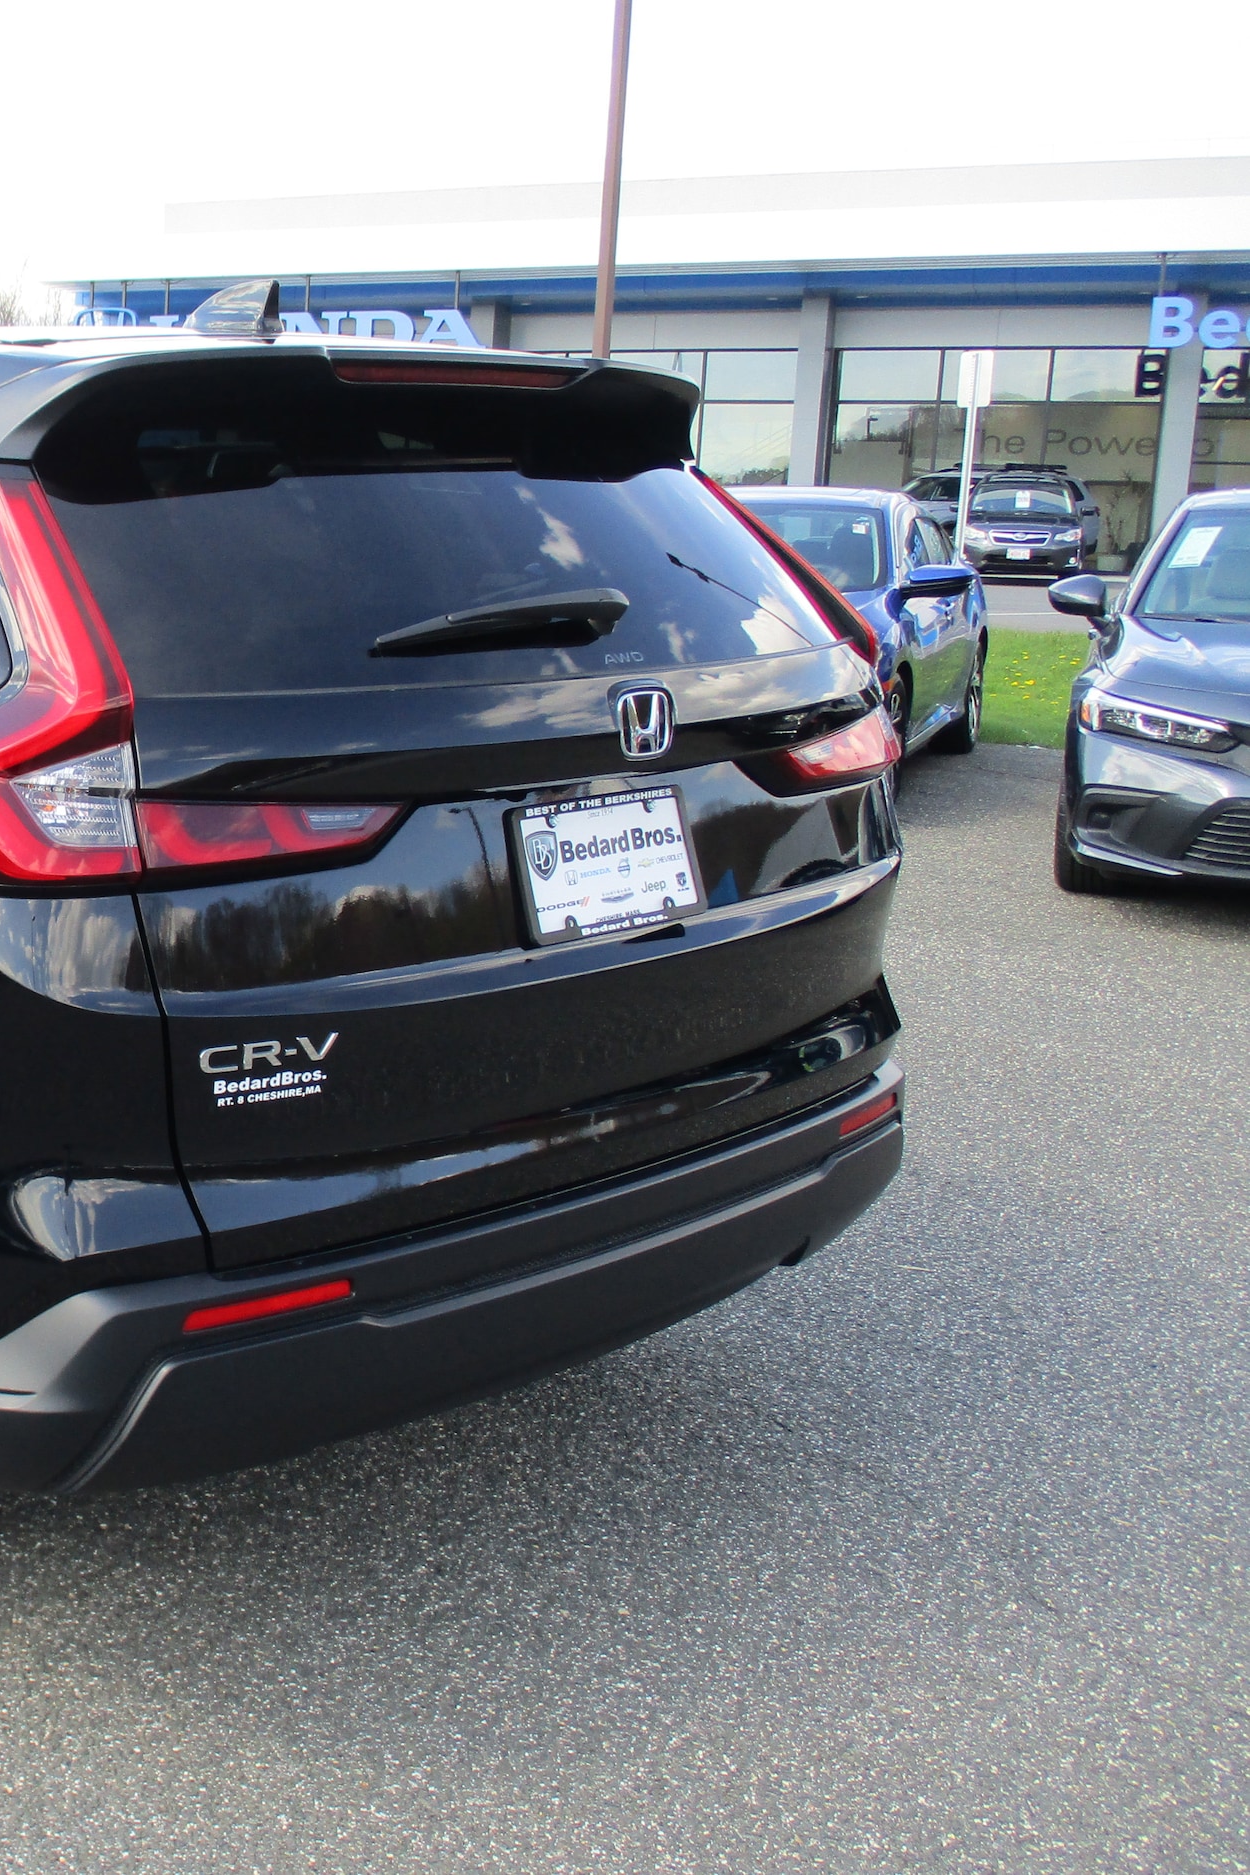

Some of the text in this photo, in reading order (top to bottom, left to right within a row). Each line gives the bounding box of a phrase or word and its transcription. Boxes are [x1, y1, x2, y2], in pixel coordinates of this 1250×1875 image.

[150, 308, 487, 349] NDA
[1148, 296, 1250, 349] Be
[1044, 429, 1161, 457] Powe
[604, 651, 644, 665] AWD
[525, 788, 672, 818] BEST OF THE BERKSHIRES
[580, 867, 611, 879] HONDA
[641, 880, 667, 893] Jeep
[581, 914, 669, 936] Bedard Bros.
[199, 1031, 340, 1075] CR-V
[213, 1069, 328, 1095] BedardBros.
[217, 1085, 322, 1107] RT. 8 CHESHIRE,MA
